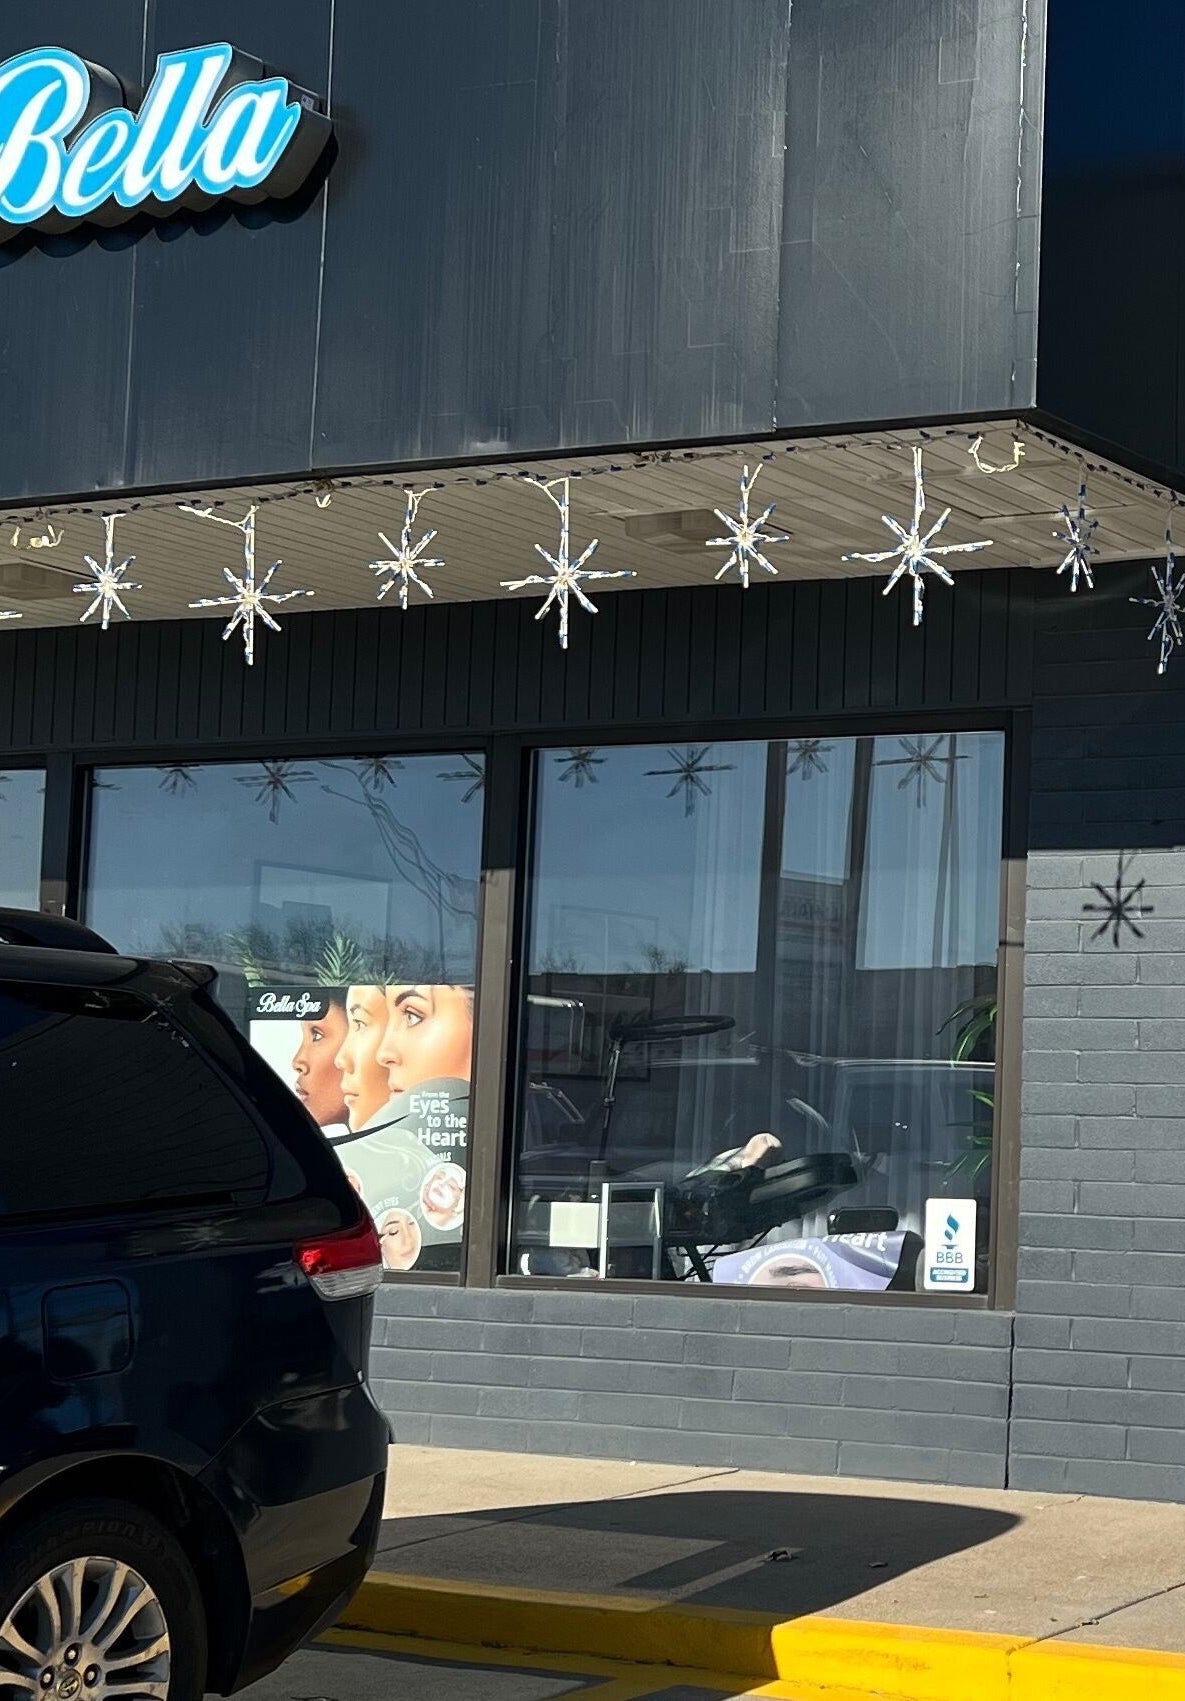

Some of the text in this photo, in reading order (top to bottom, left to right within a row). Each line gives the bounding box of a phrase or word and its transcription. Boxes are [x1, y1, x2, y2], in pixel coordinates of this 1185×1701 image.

[0, 48, 298, 219] Bella
[256, 992, 322, 1018] Bella Spa
[409, 1094, 450, 1119] Eyes
[426, 1113, 468, 1129] to the
[417, 1127, 468, 1147] Heart
[936, 1251, 963, 1264] BBB
